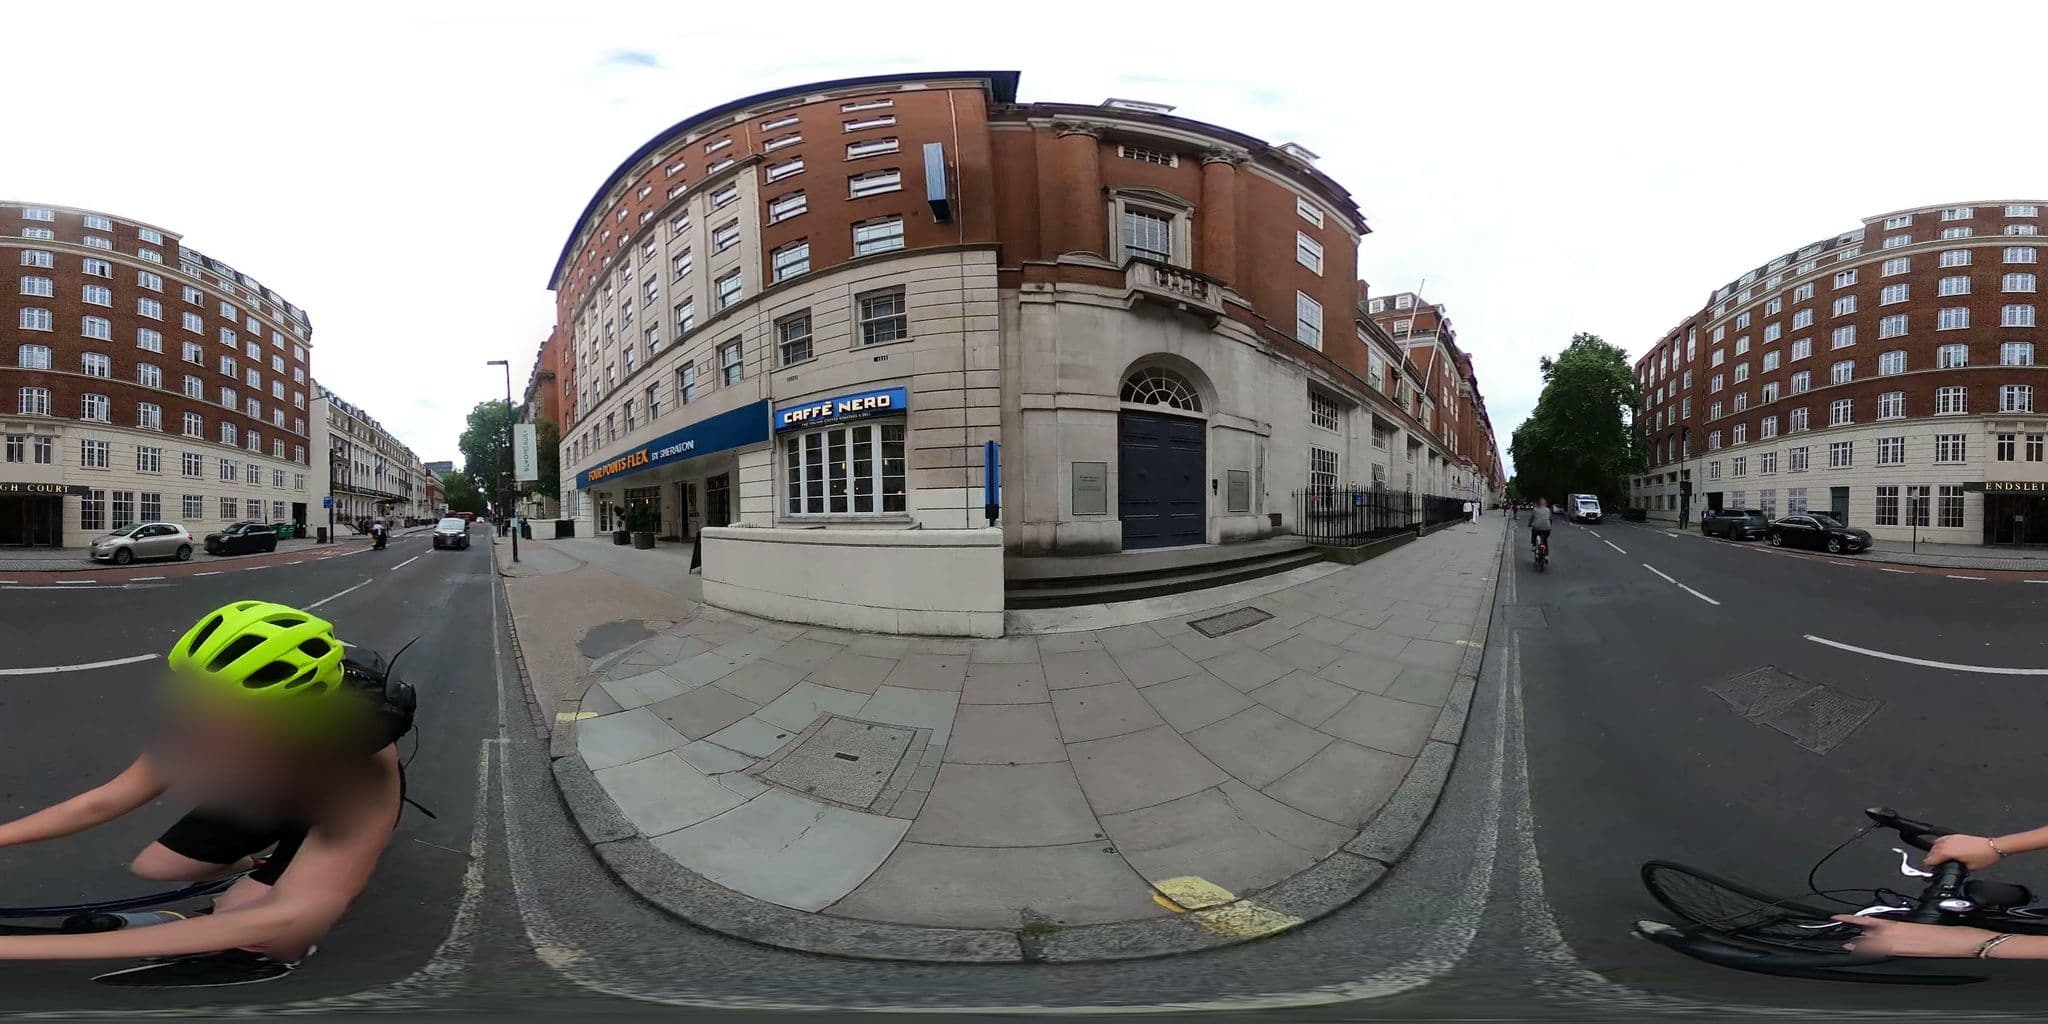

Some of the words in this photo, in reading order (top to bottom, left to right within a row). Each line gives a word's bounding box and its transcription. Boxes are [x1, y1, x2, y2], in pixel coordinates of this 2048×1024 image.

[784, 402, 833, 423] CAFFÈ
[838, 395, 890, 413] NERO
[589, 467, 604, 481] FOUR
[602, 457, 627, 476] POINTS
[627, 448, 649, 468] FLEX
[651, 450, 659, 461] BY
[659, 439, 695, 458] SHERATON
[27, 484, 70, 493] COURT
[1985, 482, 2045, 491] ENDSLEI
